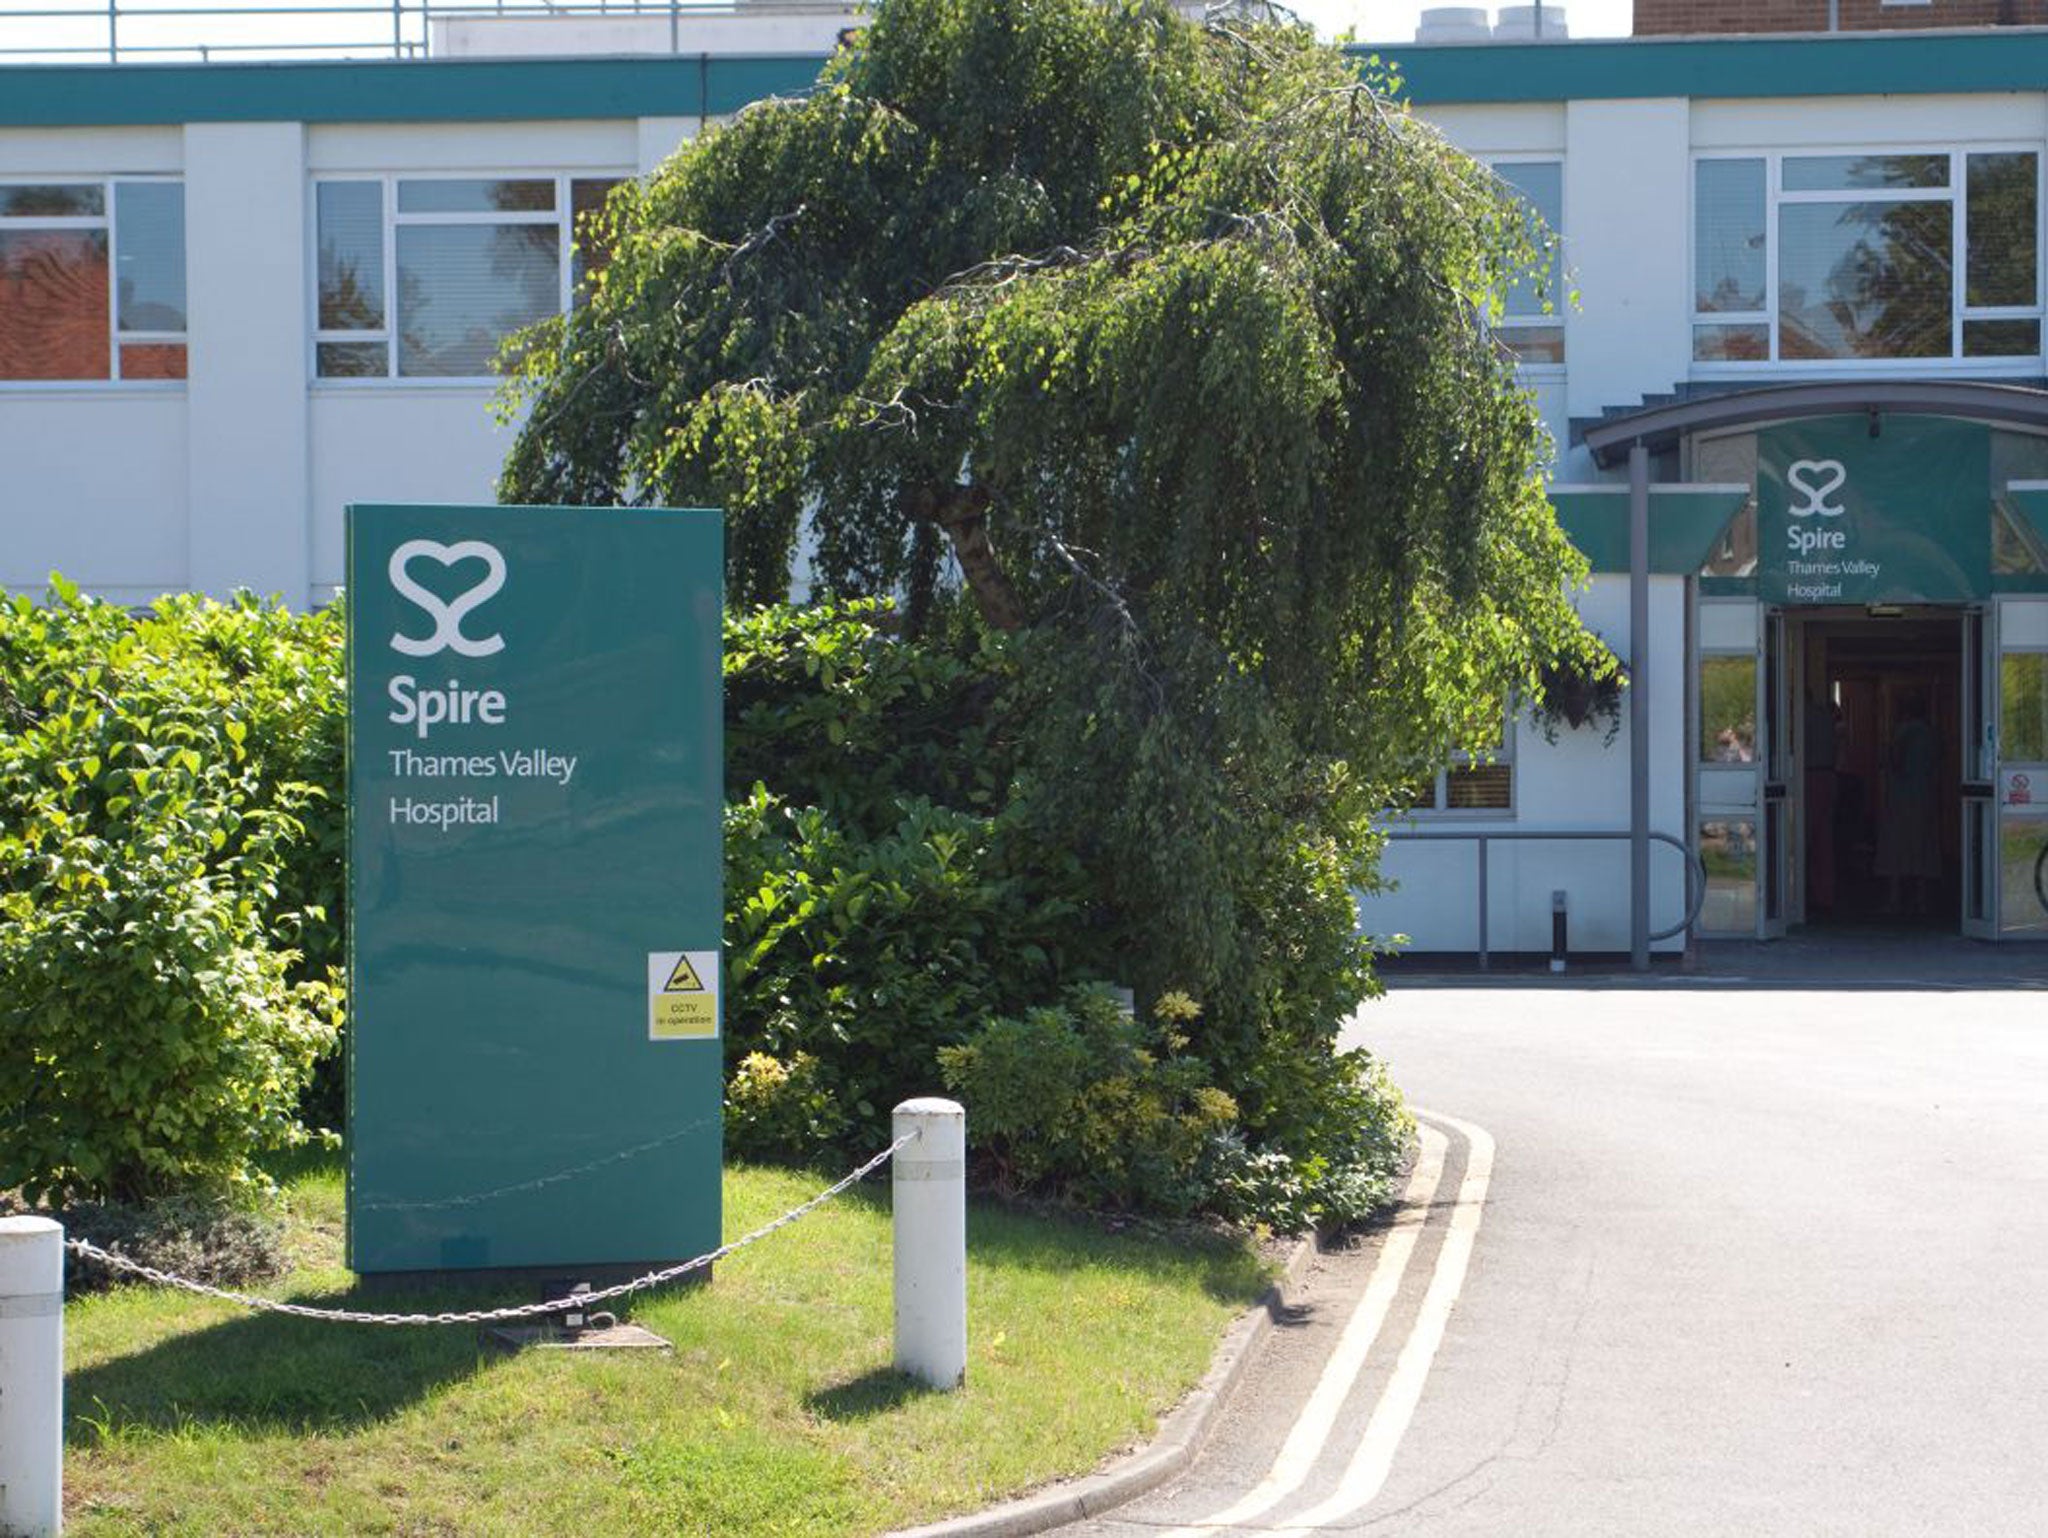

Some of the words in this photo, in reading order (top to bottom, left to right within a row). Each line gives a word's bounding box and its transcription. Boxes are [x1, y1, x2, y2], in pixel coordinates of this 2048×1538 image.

[1787, 525, 1846, 556] Spire
[1787, 561, 1841, 575] Thames
[1842, 561, 1880, 579] Valley
[1787, 583, 1842, 602] Hospital
[388, 675, 507, 739] Spire
[388, 750, 496, 778] Thames
[499, 749, 577, 786] Valley
[389, 796, 499, 832] Hospital
[670, 1003, 698, 1013] CCTV
